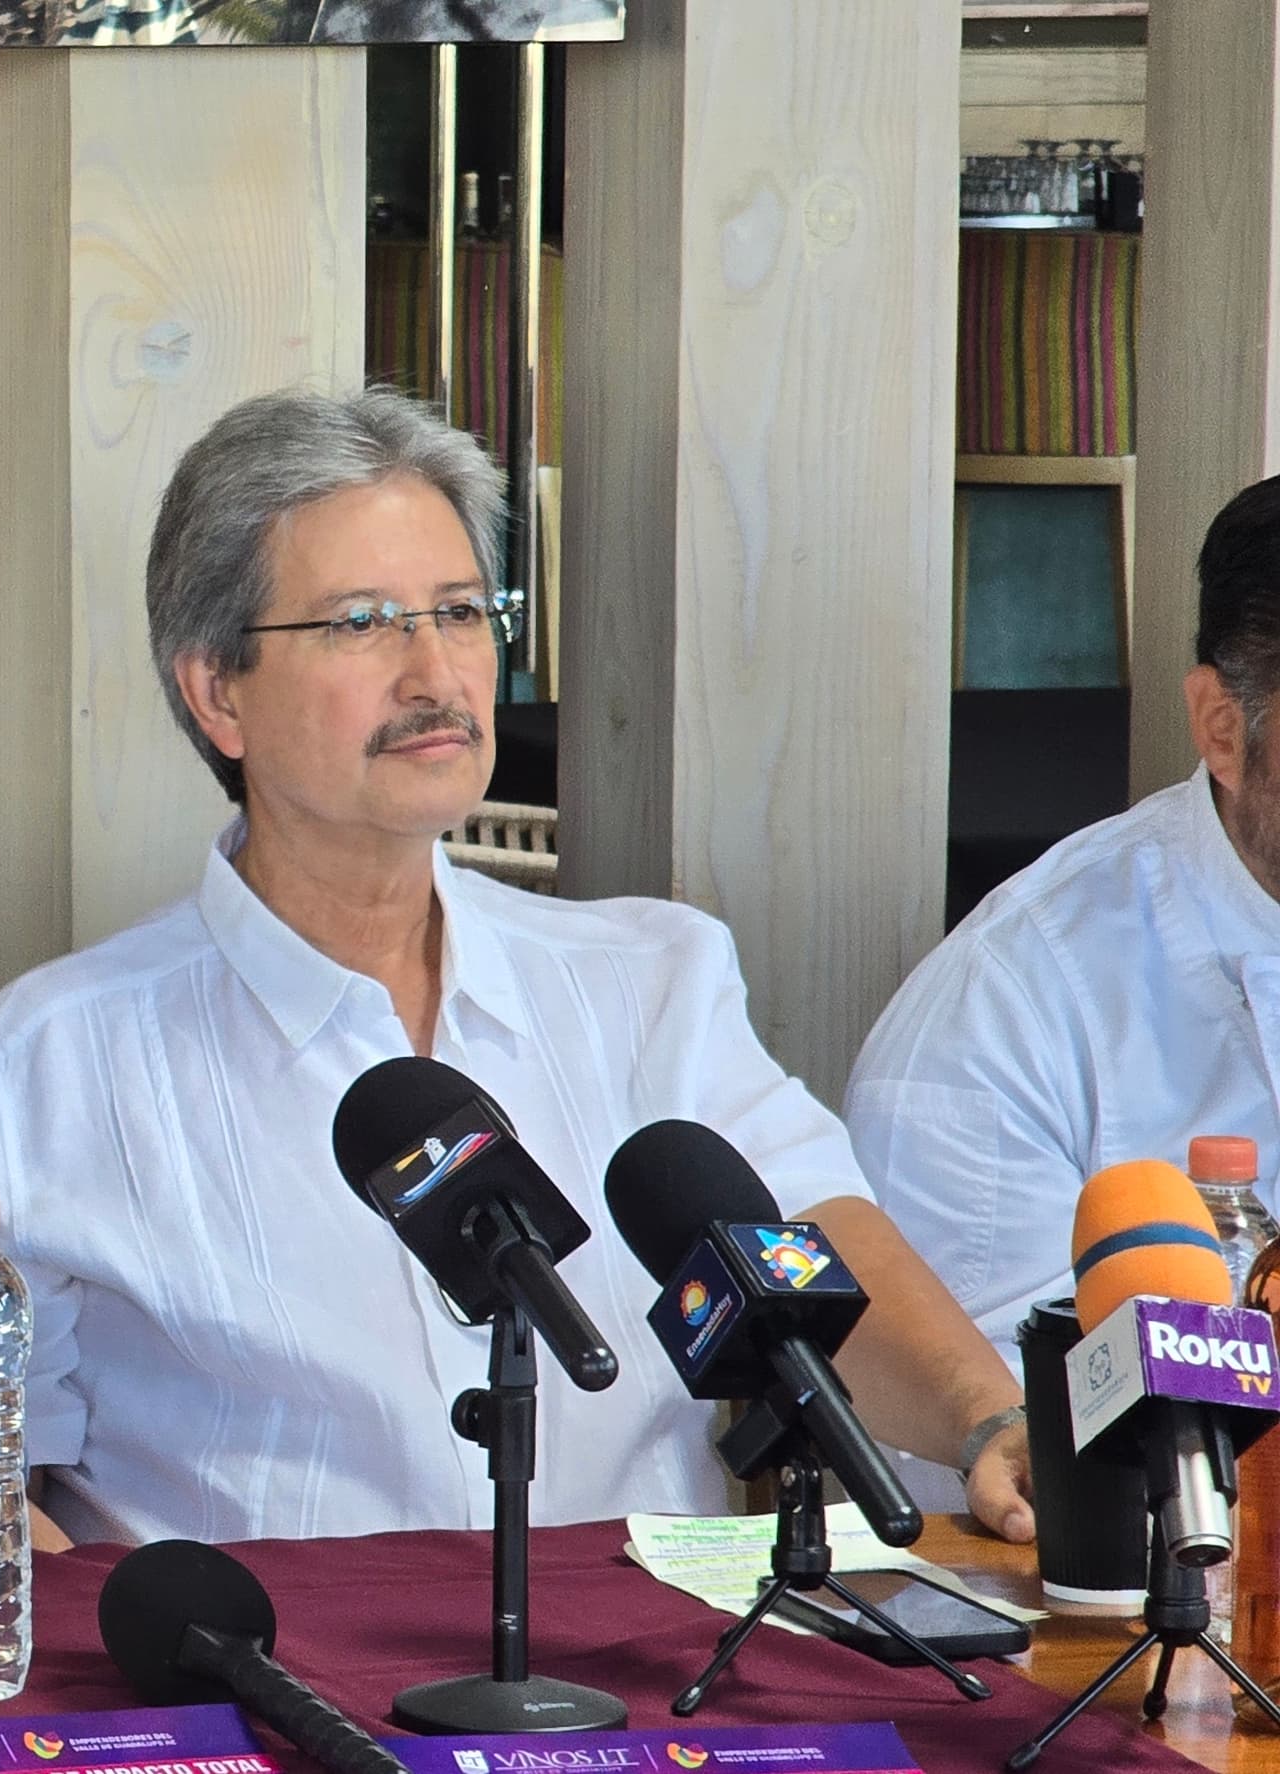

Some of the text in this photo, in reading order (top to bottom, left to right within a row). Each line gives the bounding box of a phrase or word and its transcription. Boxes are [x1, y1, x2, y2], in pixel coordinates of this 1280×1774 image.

[686, 1293, 732, 1358] EnsenadaHoy
[1235, 1374, 1272, 1395] TV
[193, 1758, 272, 1774] TOTAL
[494, 1748, 629, 1768] VINOS LT
